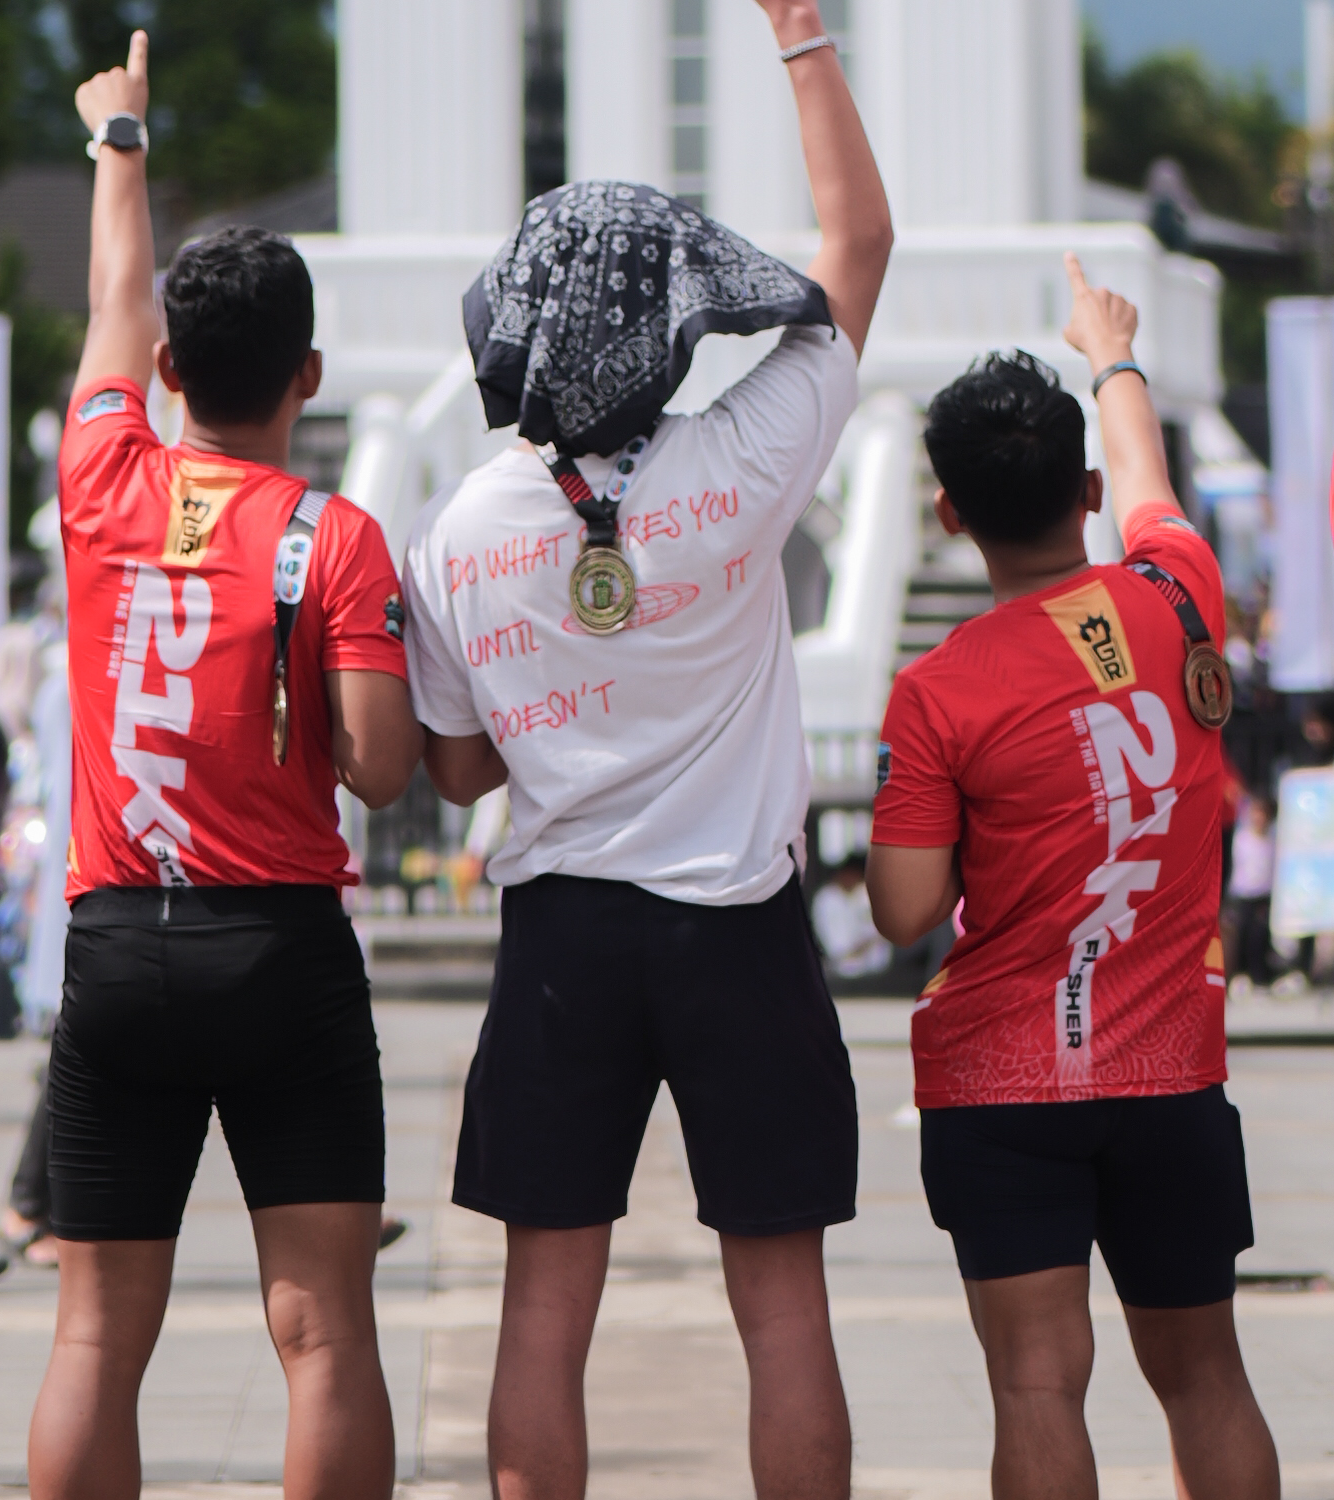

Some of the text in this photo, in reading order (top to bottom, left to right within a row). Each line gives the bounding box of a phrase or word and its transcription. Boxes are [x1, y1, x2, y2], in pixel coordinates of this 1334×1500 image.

[447, 553, 479, 594] DO
[485, 531, 570, 584] WHAT
[689, 486, 740, 533] YOU
[467, 549, 752, 668] UNTIL IT
[111, 562, 213, 854] 21K
[490, 679, 617, 746] DOESN'T
[1069, 707, 1088, 736] RUN
[1079, 739, 1098, 768] THE
[1067, 690, 1178, 956] 21K
